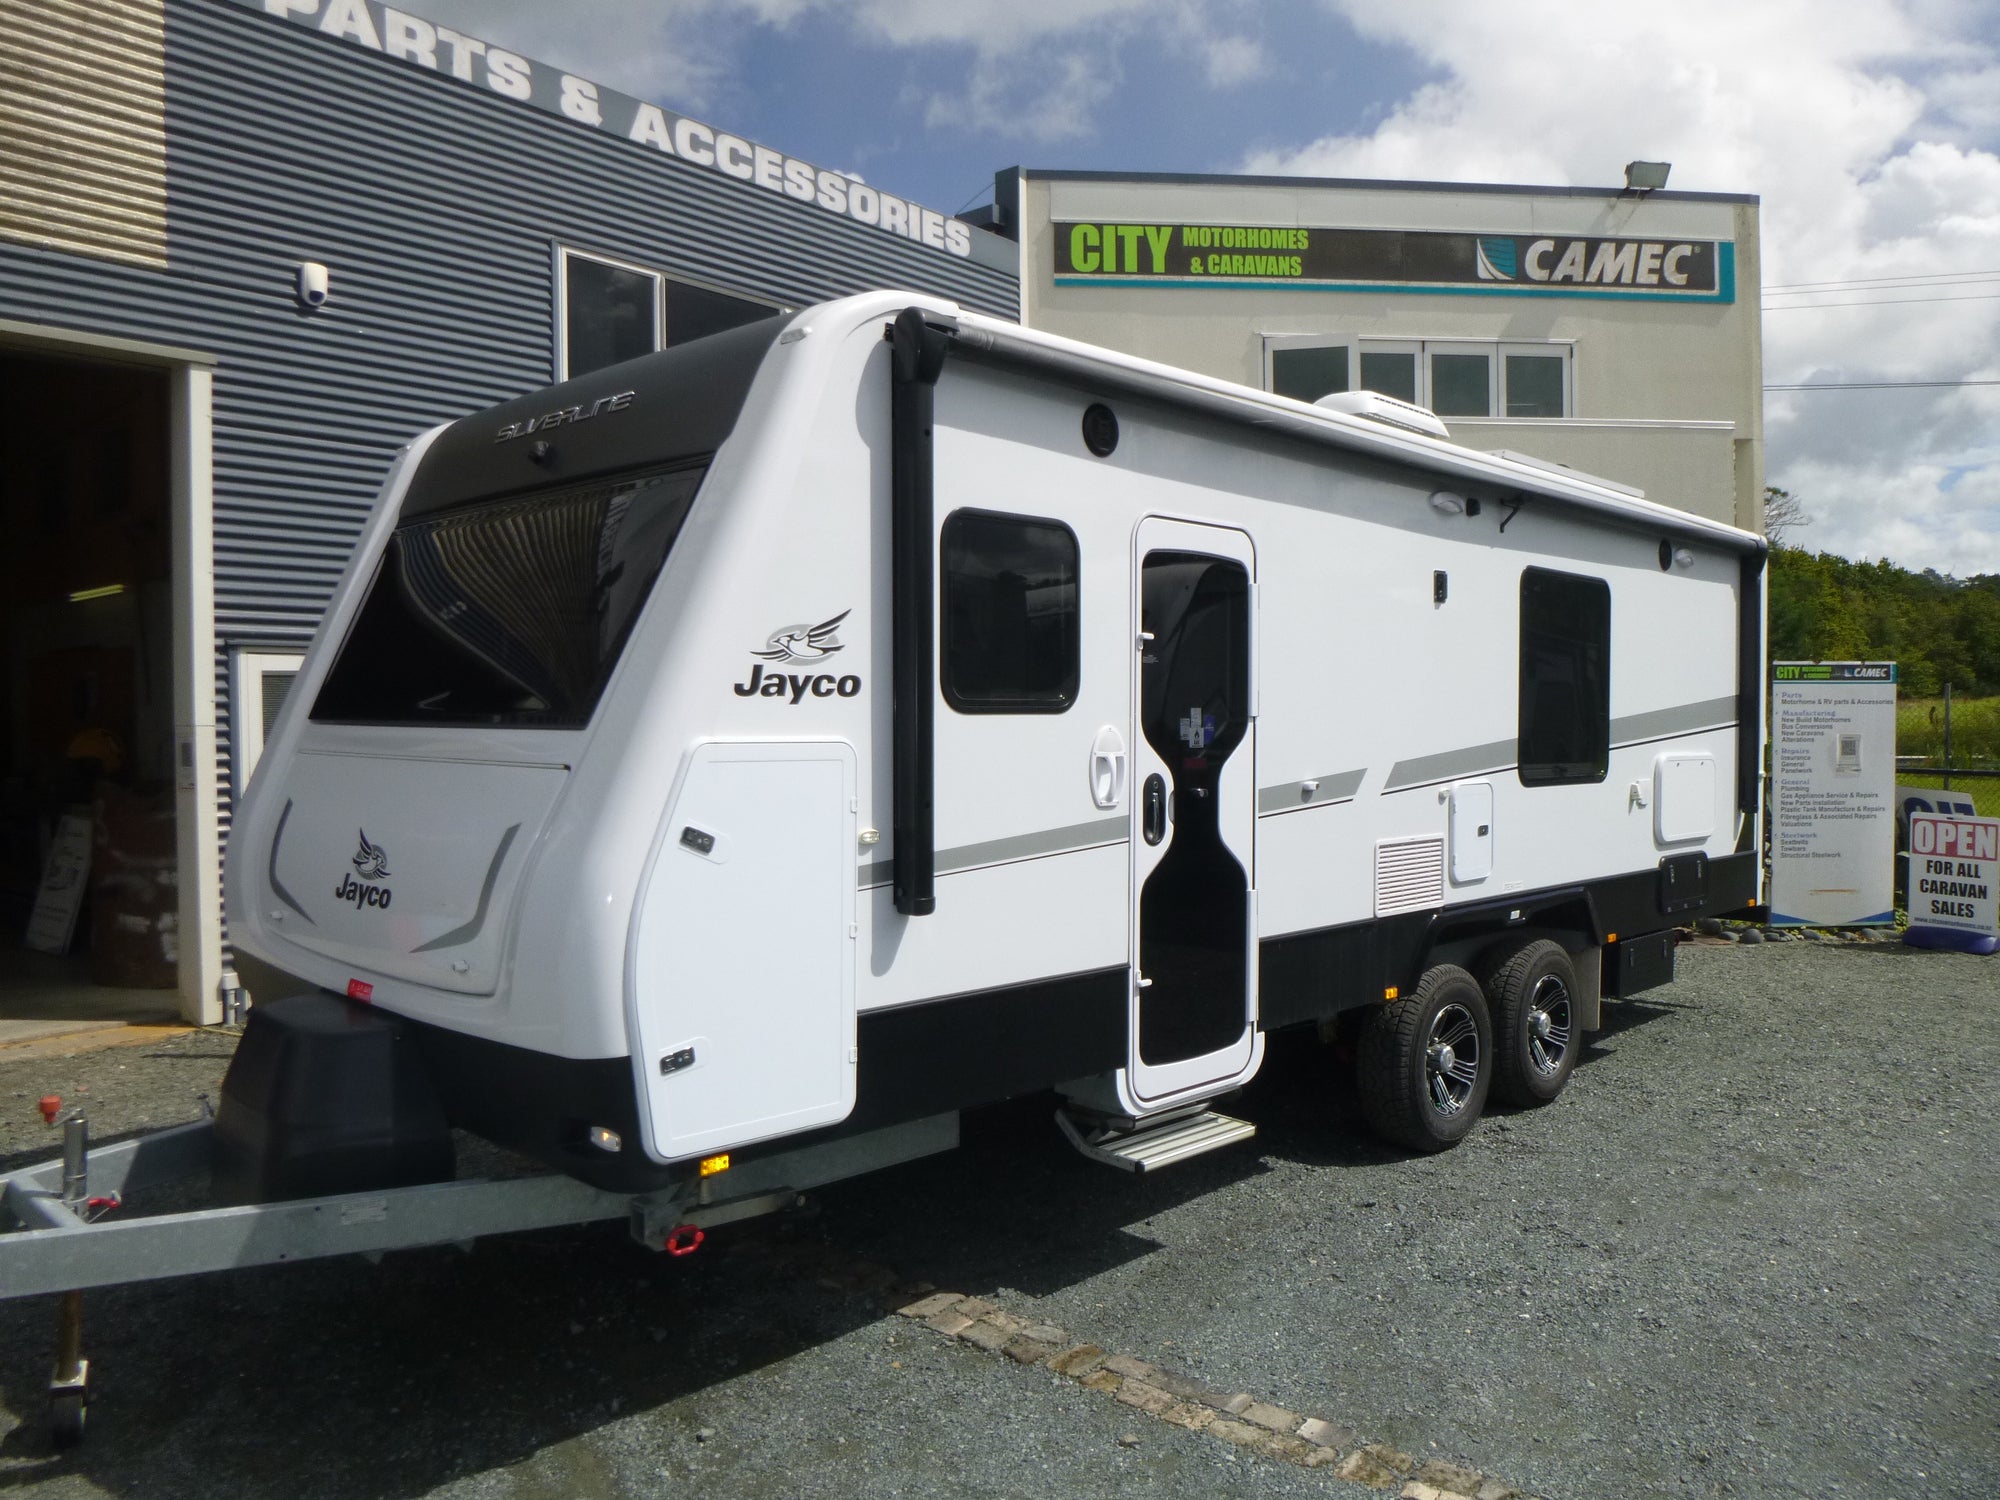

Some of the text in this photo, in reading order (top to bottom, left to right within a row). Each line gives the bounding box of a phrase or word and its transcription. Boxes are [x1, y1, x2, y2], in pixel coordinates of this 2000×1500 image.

[561, 74, 602, 126] &
[629, 103, 970, 257] ACCESSORIES
[1070, 224, 1173, 273] CITY
[1183, 227, 1309, 249] MOTORHOMES
[1190, 254, 1302, 276] & CARAVANS
[1525, 239, 1693, 285] CAMEC
[495, 390, 636, 443] SILVERLINE
[734, 664, 862, 705] Jayco
[1776, 666, 1801, 679] CITY
[1853, 668, 1888, 678] CAMEC
[1913, 820, 1996, 859] OPEN
[1926, 859, 1981, 878] FOR ALL
[335, 872, 392, 910] Jayco
[1919, 878, 1987, 899] CARAVAN
[1931, 900, 1974, 918] SALES
